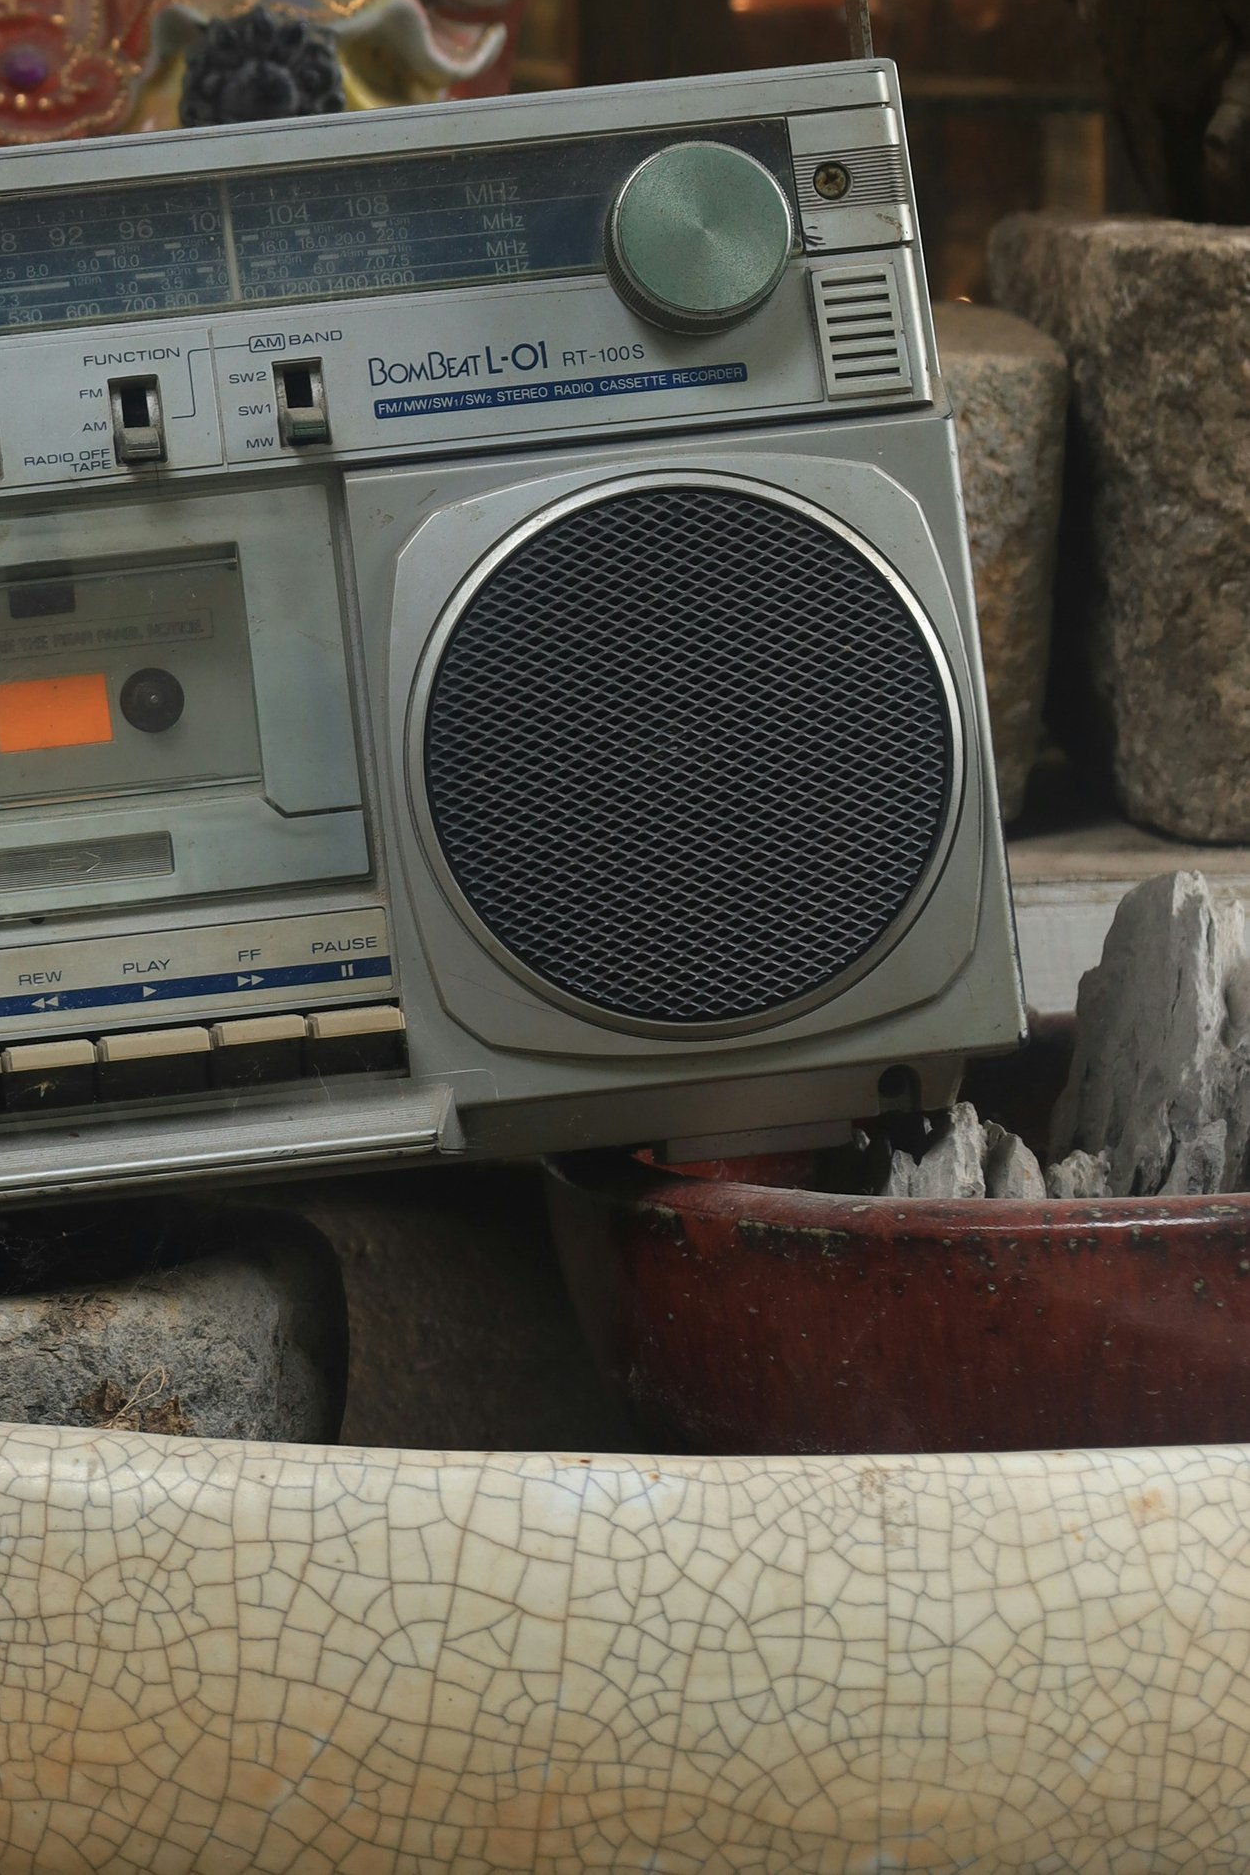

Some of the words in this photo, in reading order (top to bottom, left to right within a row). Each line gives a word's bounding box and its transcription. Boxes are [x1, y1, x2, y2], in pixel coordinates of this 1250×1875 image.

[49, 226, 83, 247] 92
[119, 219, 153, 240] 96
[266, 204, 310, 225] 104
[345, 195, 390, 217] 108
[464, 182, 522, 205] MHz
[26, 264, 49, 278] 8.0
[78, 258, 100, 272] 9.0
[112, 254, 140, 269] 10.0
[170, 248, 199, 263] 12.0
[261, 239, 288, 252] 16.0
[300, 235, 328, 249] 18.0
[335, 231, 365, 245] 20.0
[377, 227, 408, 241] 22.0
[483, 212, 525, 230] MHz
[115, 281, 138, 295] 3.0
[160, 276, 183, 290] 3.5
[205, 271, 228, 285] 4.0
[313, 261, 335, 275] 6.0
[365, 256, 385, 270] 7.0
[389, 253, 410, 267] 7.5
[486, 239, 527, 257] MHz
[8, 309, 43, 324] 530
[66, 302, 100, 318] 600
[123, 296, 156, 312] 700
[165, 291, 199, 306] 800
[279, 279, 321, 296] 1200
[328, 274, 368, 291] 1400
[373, 269, 415, 286] 1600
[494, 258, 528, 275] kHz
[253, 336, 282, 350] AM
[289, 330, 342, 346] BAND
[83, 347, 180, 367] FUNCTION
[562, 344, 645, 367] RT-100S
[229, 371, 267, 384] SW2
[497, 386, 548, 403] STEREO
[554, 382, 594, 396] RADIO
[600, 375, 668, 392] CASSETTE
[672, 367, 743, 384] RECORDER
[79, 388, 103, 400] FM
[238, 404, 272, 416] SW1
[82, 421, 108, 432] AM
[246, 437, 274, 449] MW
[24, 452, 75, 467] RADIO
[79, 448, 111, 460] OFF
[70, 460, 112, 474] TAPE
[311, 936, 379, 954] PAUSE
[238, 948, 262, 962] FF
[122, 958, 171, 974] PLAY
[18, 970, 63, 986] REW
